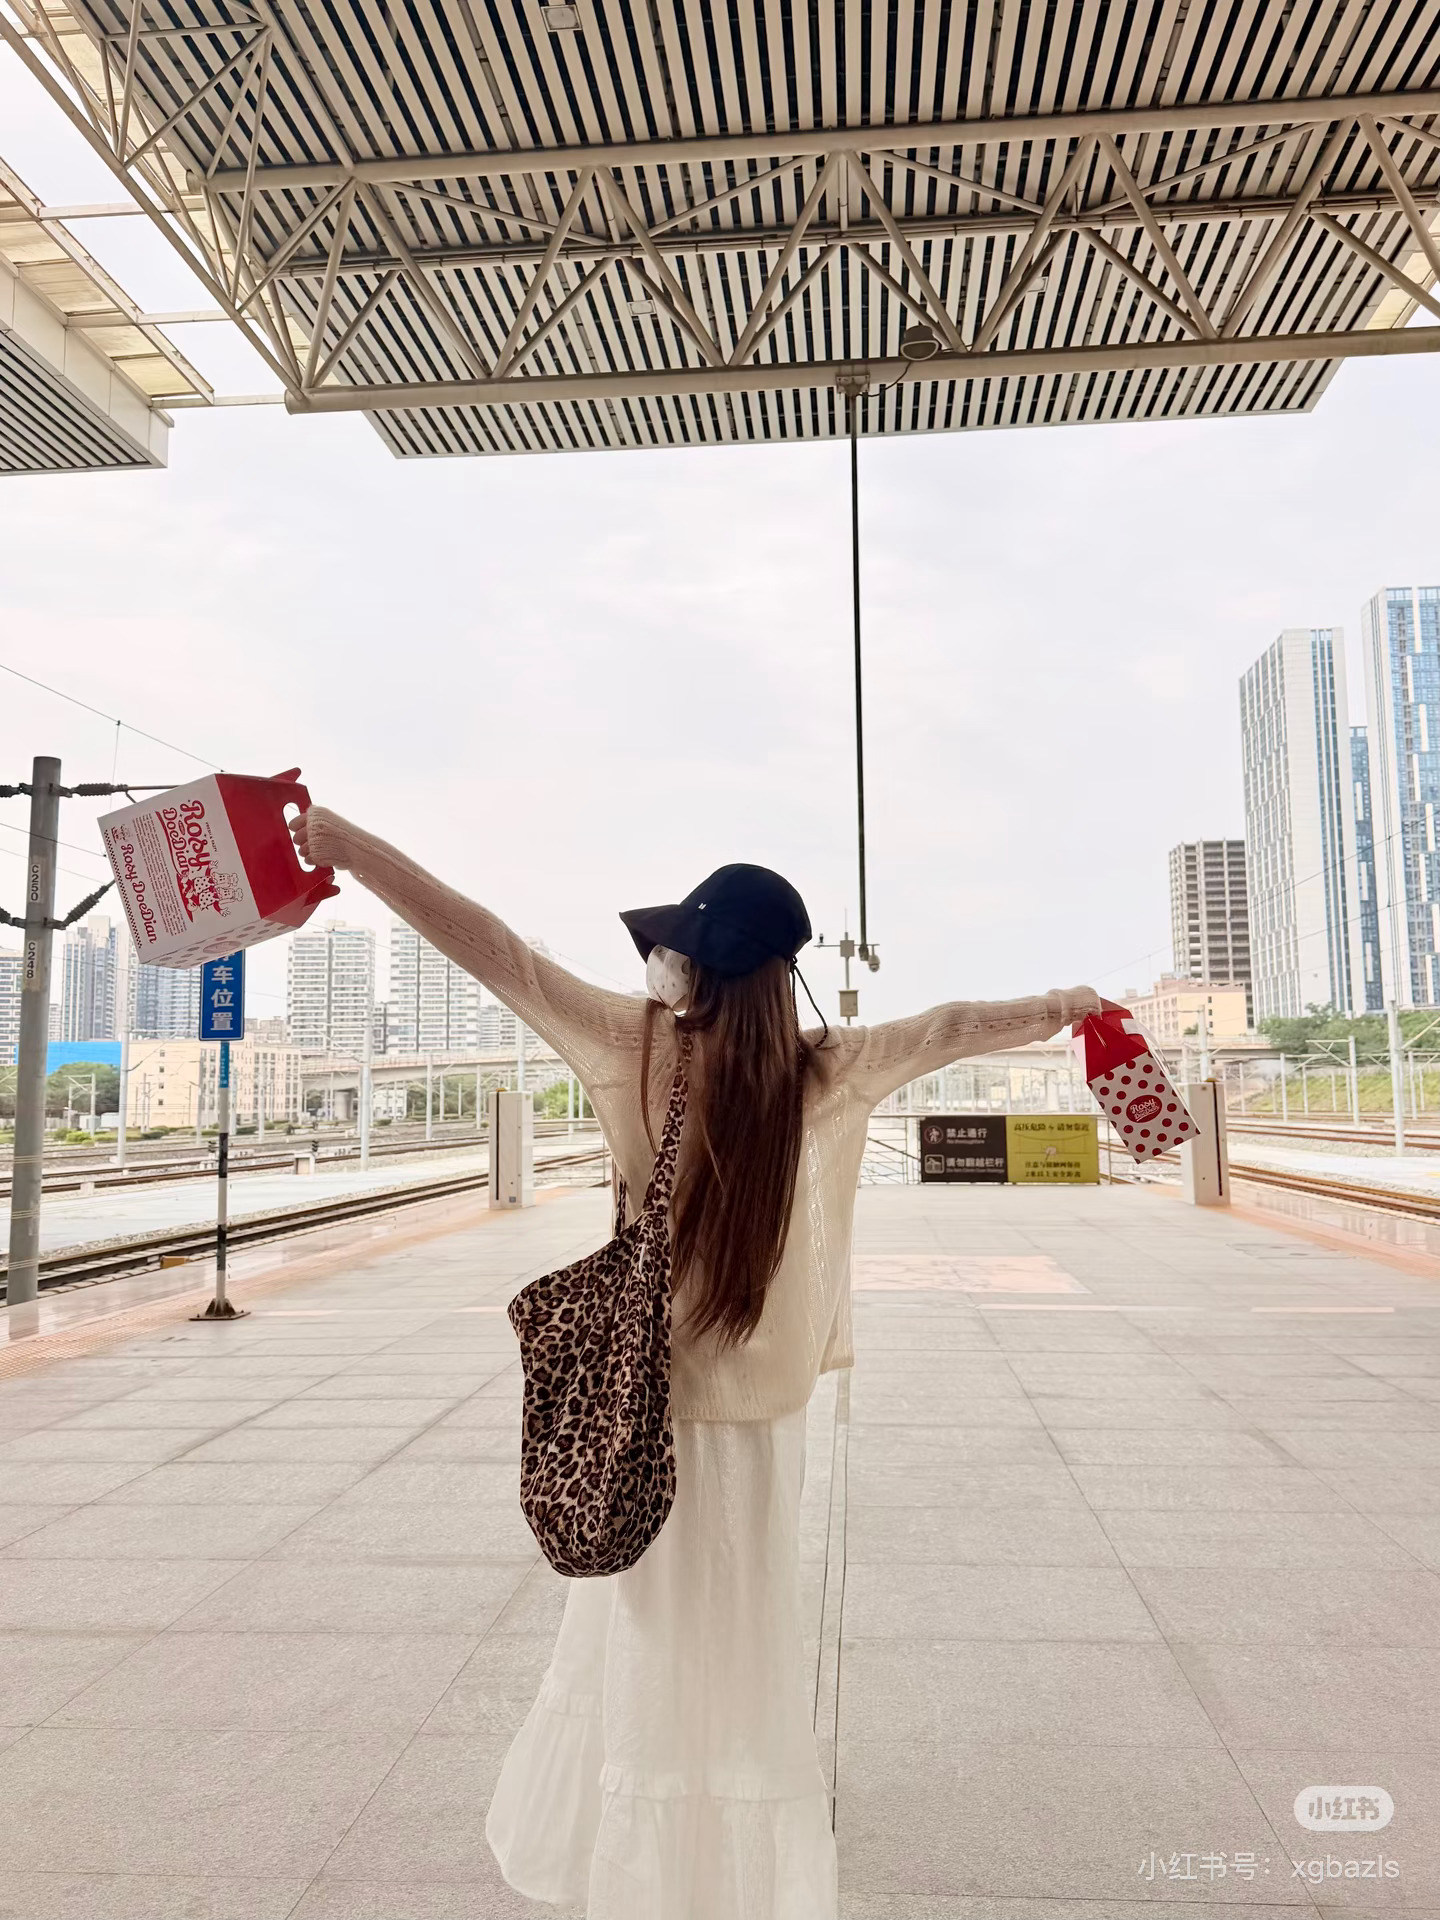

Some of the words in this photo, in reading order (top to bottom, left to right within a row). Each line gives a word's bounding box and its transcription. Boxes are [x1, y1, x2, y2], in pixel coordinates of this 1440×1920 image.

[180, 800, 211, 872] Rosy
[31, 864, 40, 901] C250
[121, 843, 138, 882] Rosy
[132, 880, 158, 944] DoeDian
[26, 942, 36, 979] C248
[1130, 1098, 1156, 1114] Rosy
[946, 1128, 987, 1138] 禁止通行
